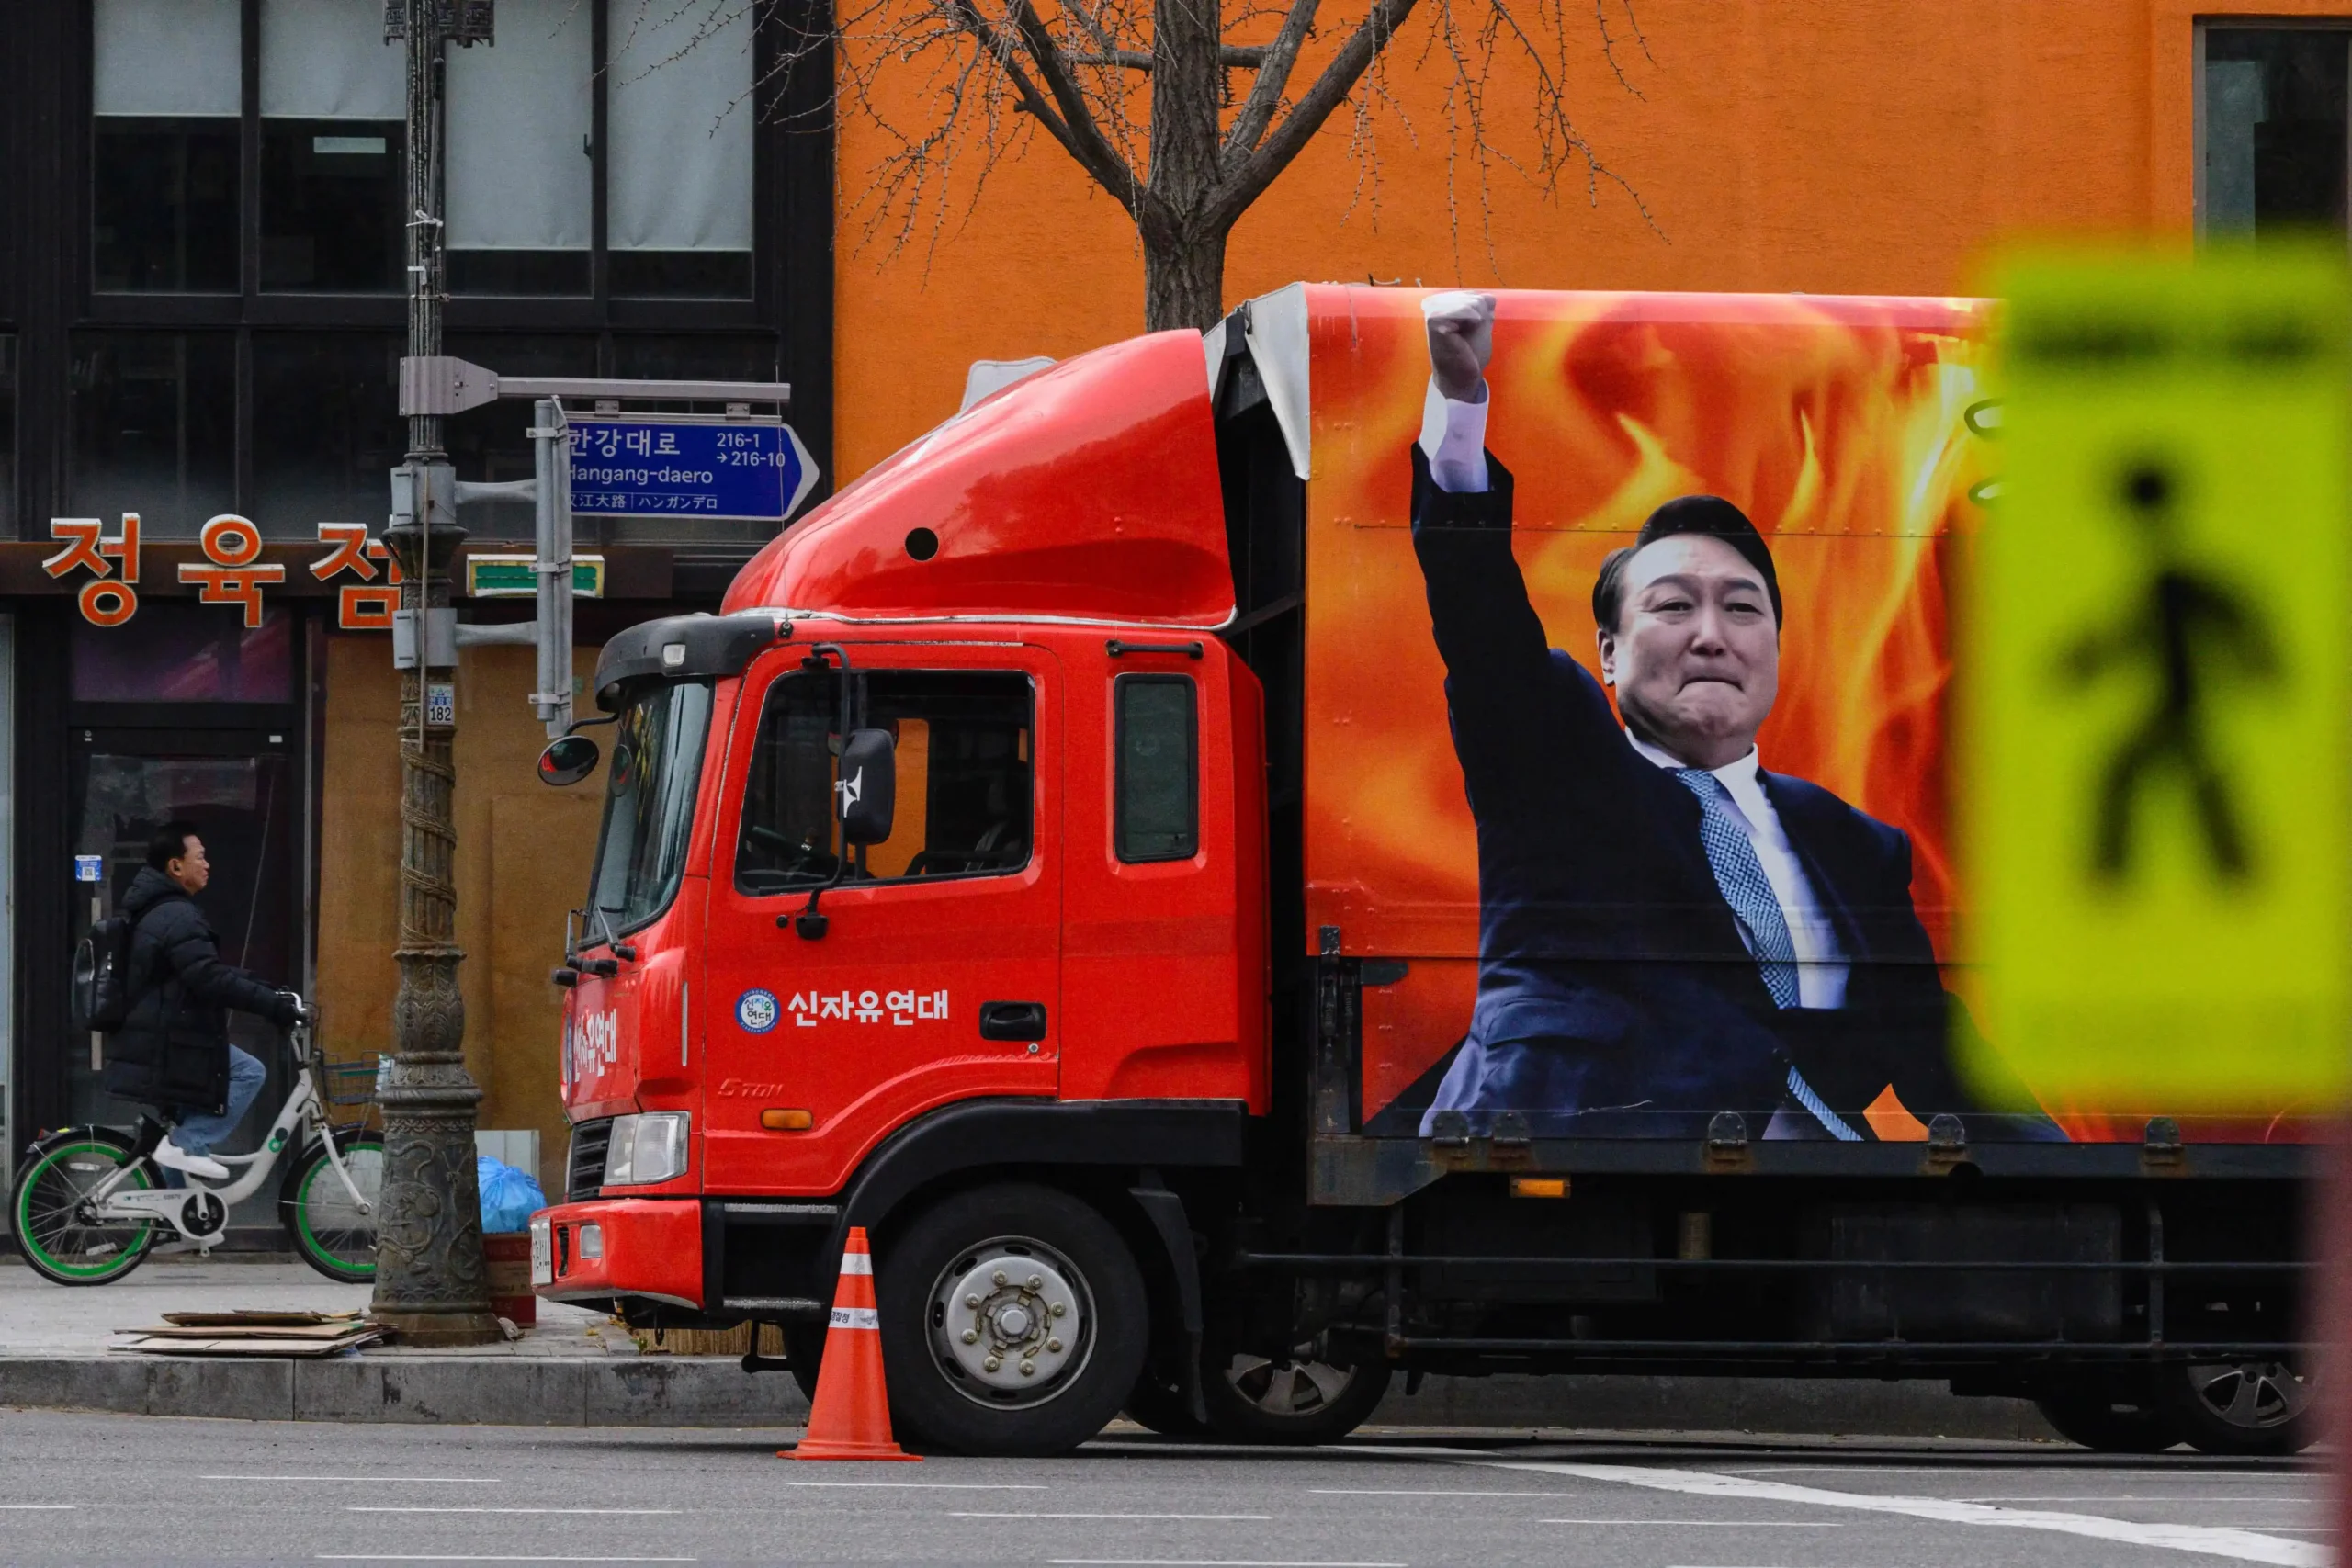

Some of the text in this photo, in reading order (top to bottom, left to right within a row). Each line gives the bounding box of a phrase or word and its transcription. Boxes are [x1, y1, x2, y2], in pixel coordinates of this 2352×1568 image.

[569, 428, 680, 457] 한강대로
[717, 433, 760, 448] 216-1
[731, 451, 786, 467] 216-10
[639, 495, 718, 510] ハンガンデロ
[42, 512, 402, 629] 정육점
[430, 706, 451, 721] 182
[788, 990, 948, 1027] 신자유연대
